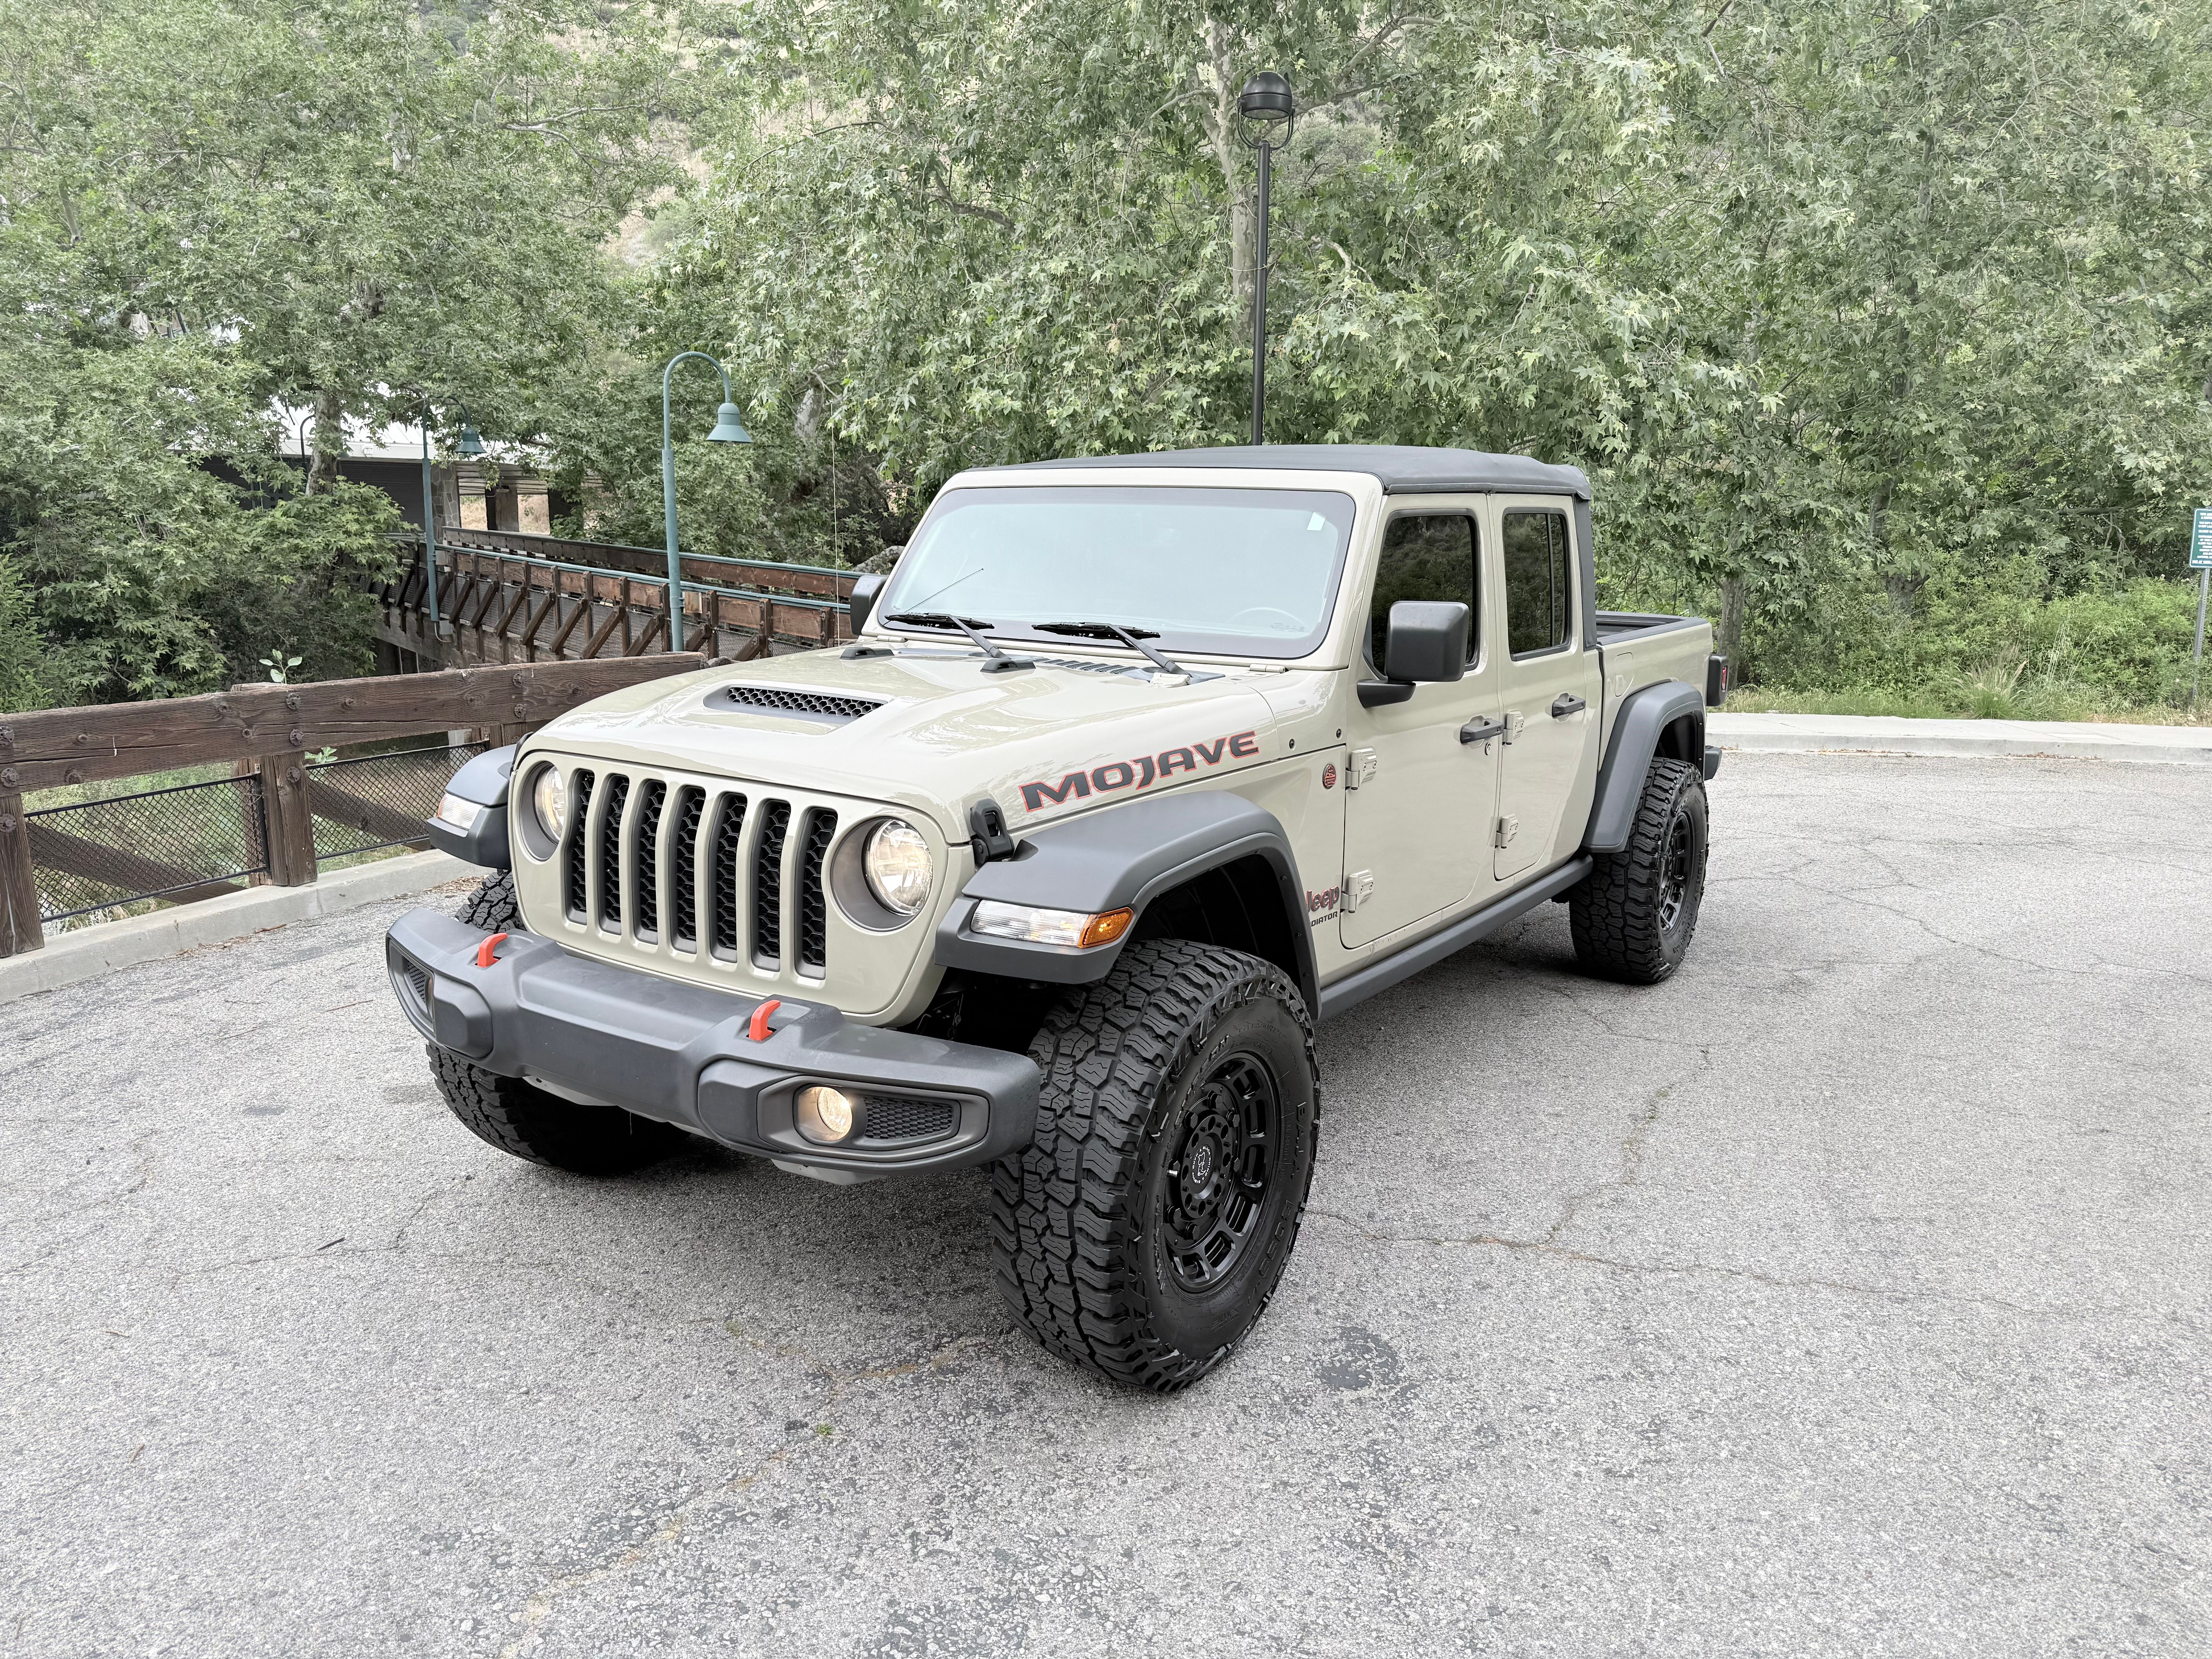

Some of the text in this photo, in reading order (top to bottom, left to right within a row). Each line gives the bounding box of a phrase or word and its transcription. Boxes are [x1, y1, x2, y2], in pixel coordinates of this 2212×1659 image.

[1018, 730, 1259, 812] MOJAVE
[1306, 886, 1340, 912] Jeep
[1310, 911, 1338, 927] DIATOR
[1289, 1101, 1307, 1181] BAJA
[1259, 1199, 1294, 1279] BOSS
